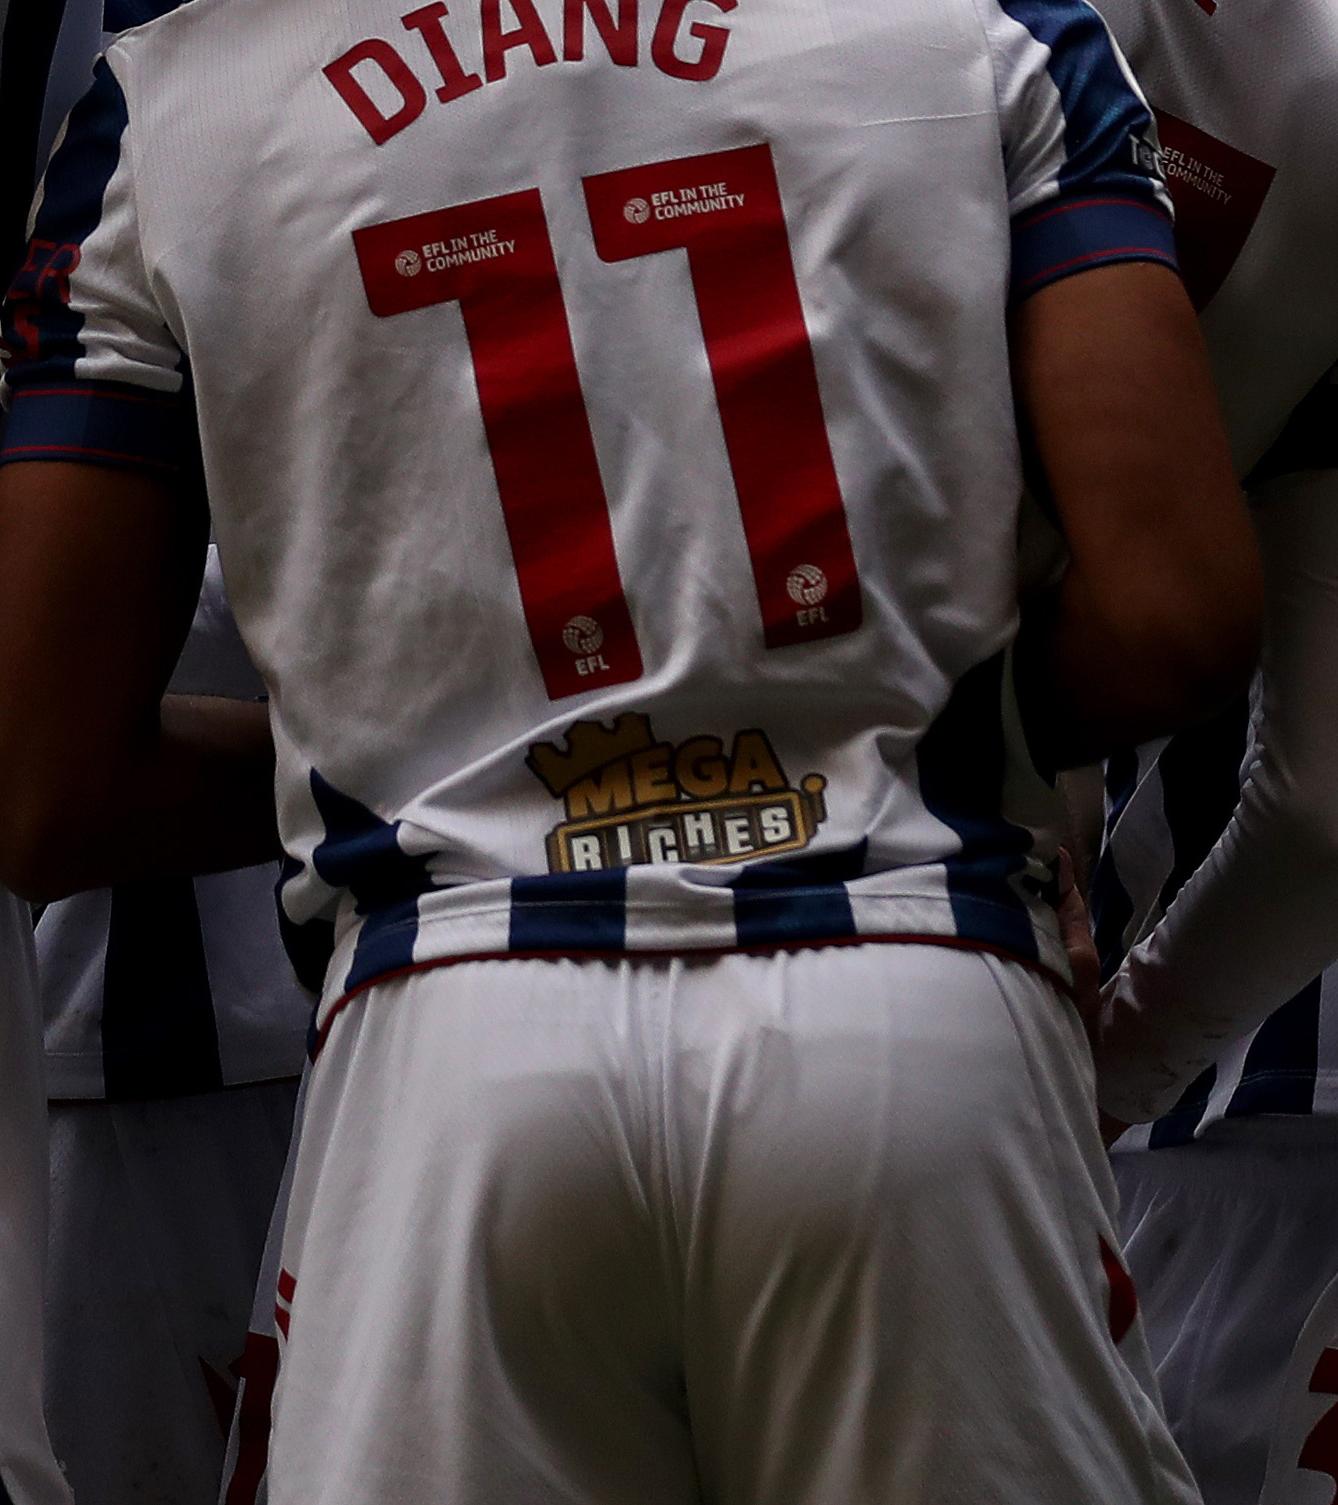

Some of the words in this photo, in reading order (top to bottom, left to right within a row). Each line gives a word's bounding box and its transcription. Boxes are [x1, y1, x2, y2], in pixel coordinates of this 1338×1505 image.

[1163, 146, 1186, 167] EFL
[1186, 156, 1204, 175] IN
[1204, 165, 1226, 188] THE
[649, 190, 678, 208] EFL
[678, 187, 698, 203] IN
[698, 182, 727, 199] THE
[655, 193, 746, 221] COMMUNITY
[421, 240, 449, 259] EFL
[449, 235, 468, 252] IN
[469, 229, 498, 247] THE
[426, 239, 516, 273] COMMUNITY
[352, 143, 862, 701] 11
[795, 606, 831, 627] EFL
[574, 654, 611, 677] EFL
[565, 728, 789, 820] MEGA
[570, 805, 792, 871] RICHES
